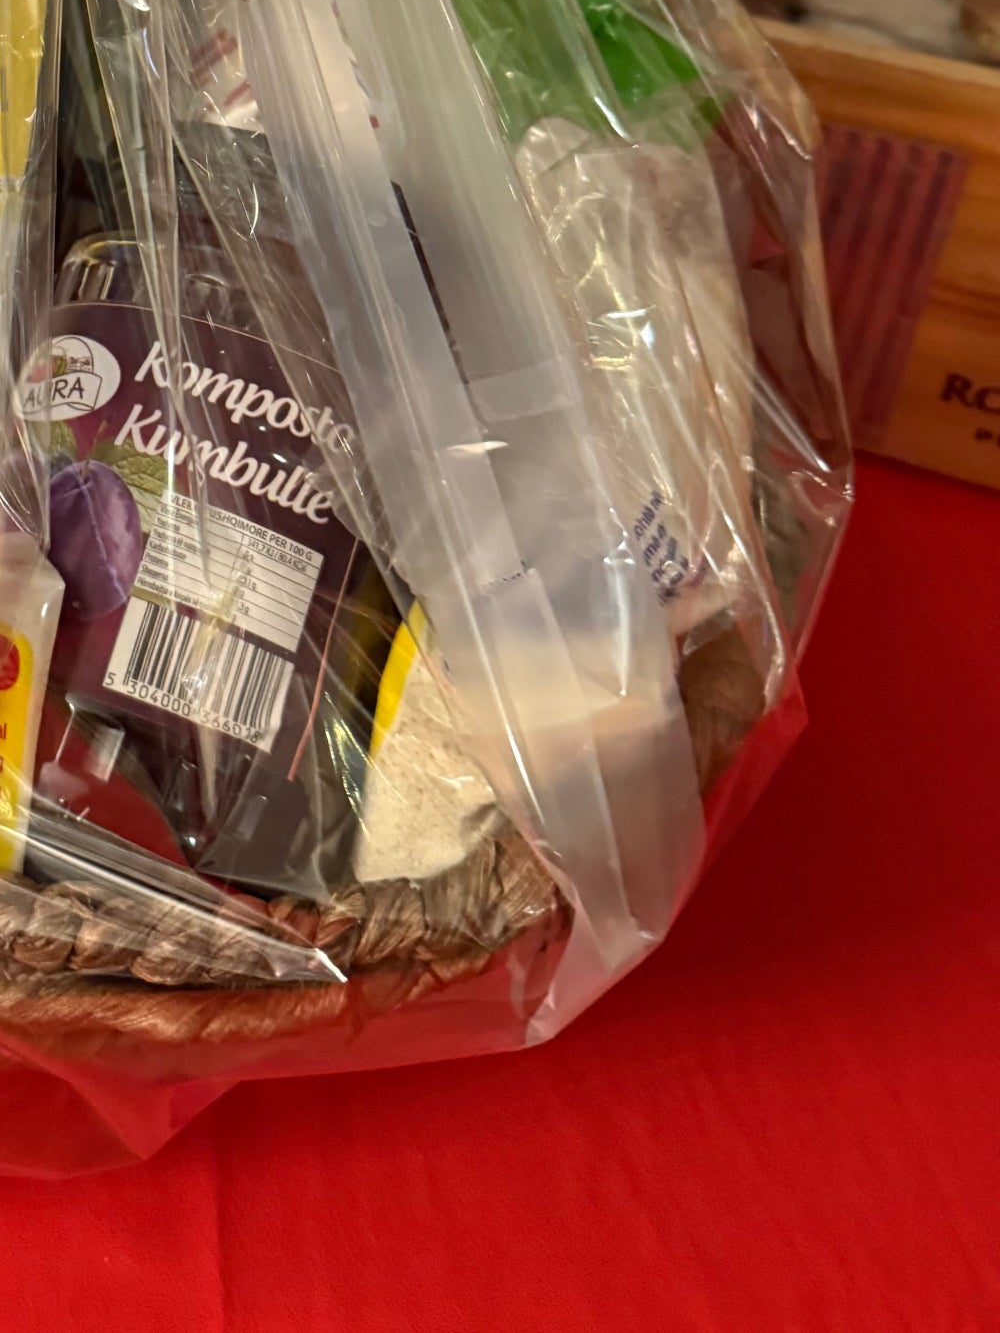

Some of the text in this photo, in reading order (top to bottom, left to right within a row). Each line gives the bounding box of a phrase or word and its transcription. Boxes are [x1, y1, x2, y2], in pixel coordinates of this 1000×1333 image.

[269, 533, 288, 549] PER
[289, 541, 306, 557] 100
[305, 551, 314, 562] G
[104, 672, 117, 686] 5
[126, 679, 192, 717] 304000
